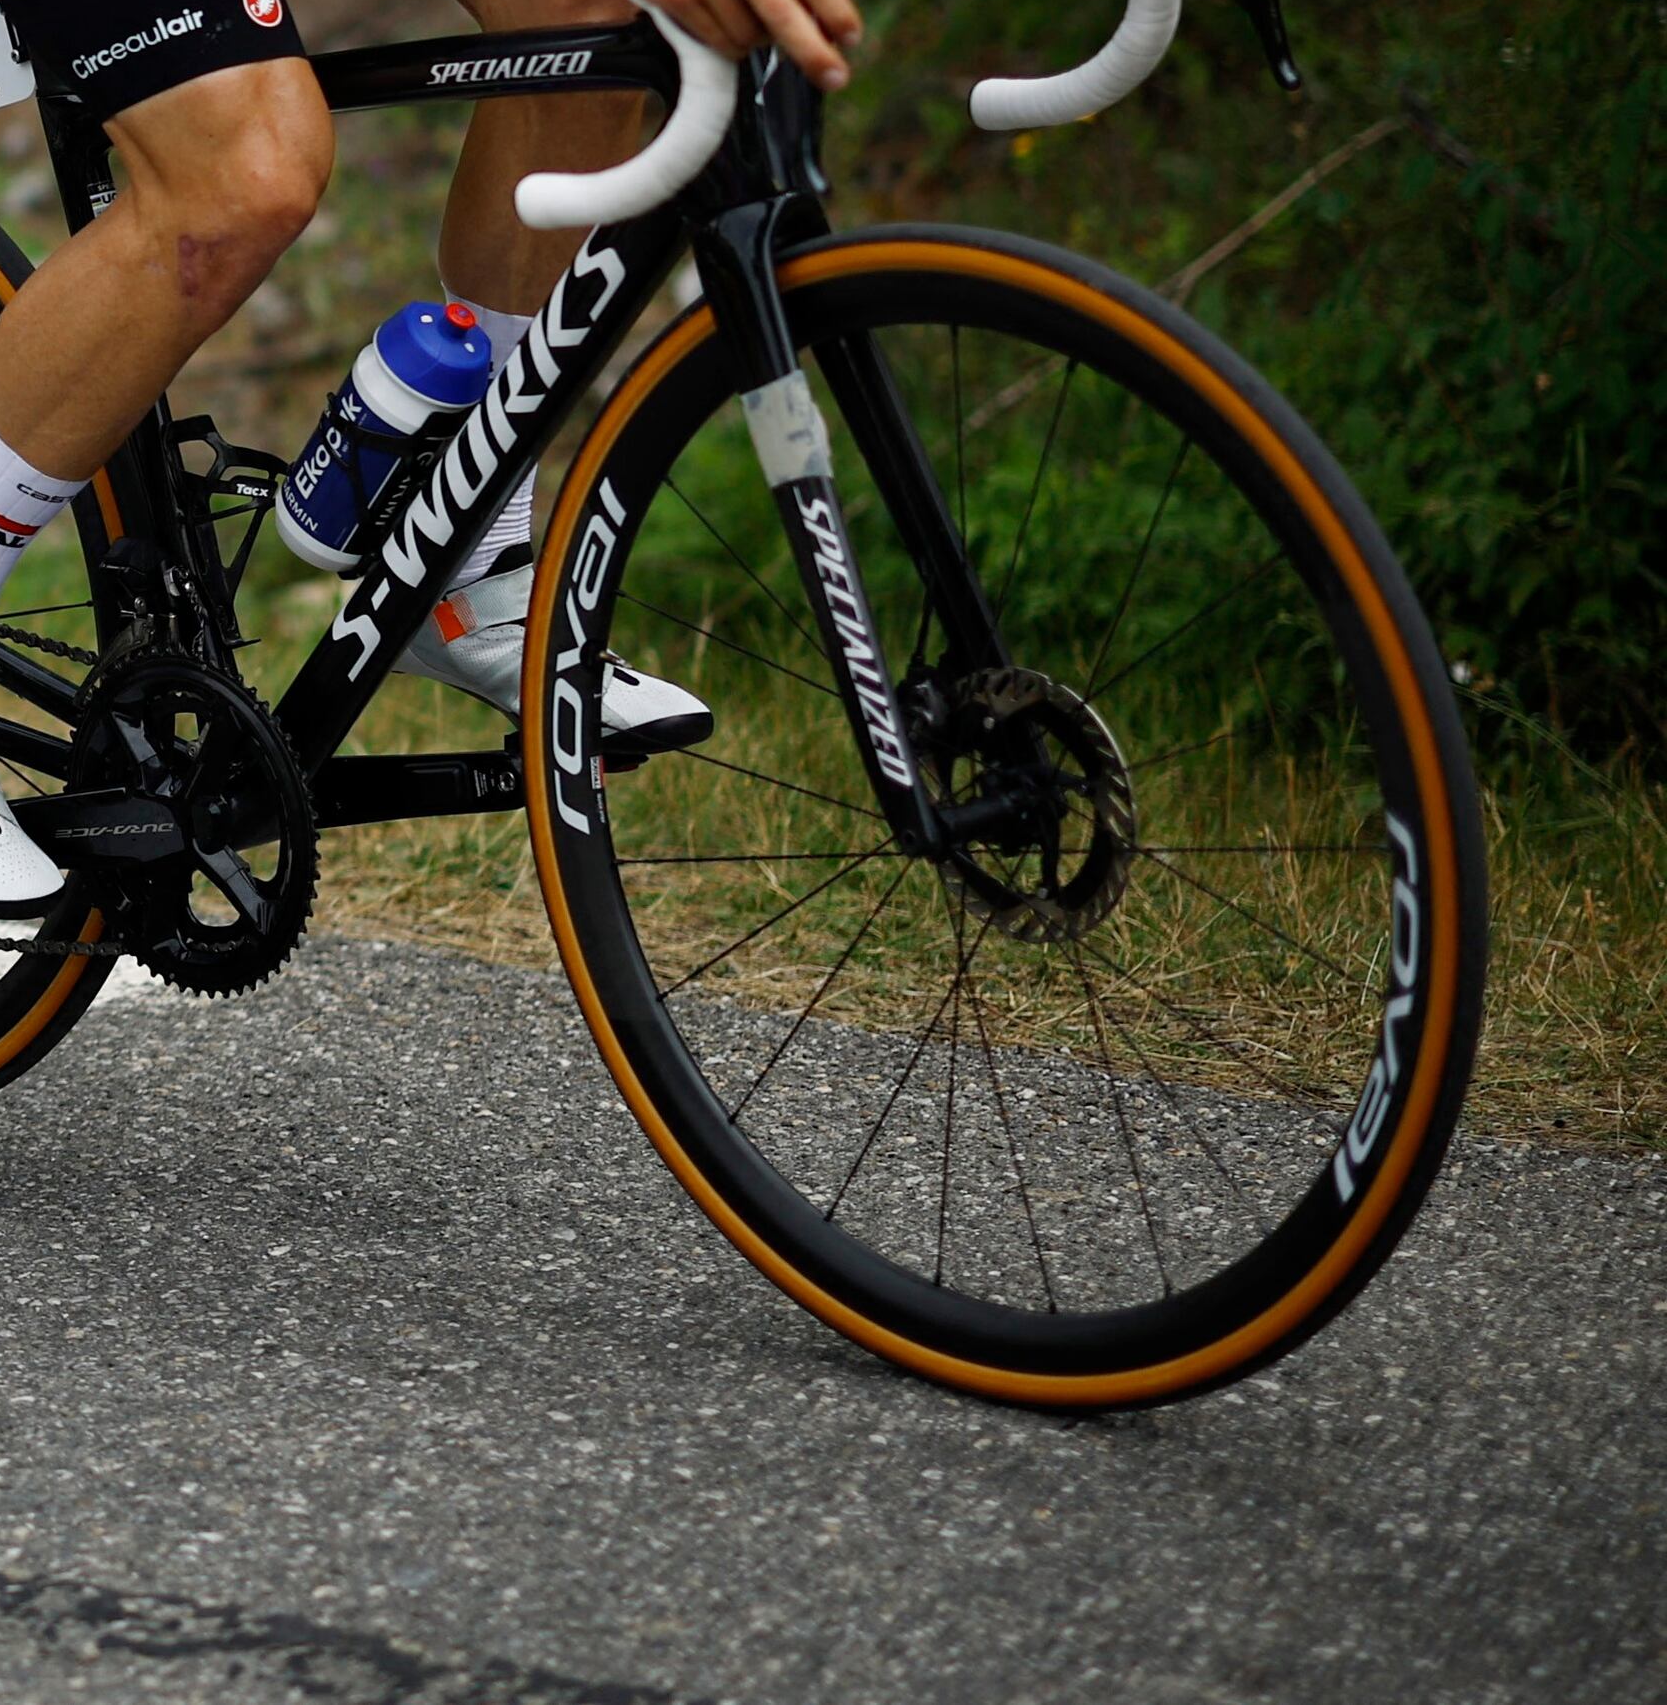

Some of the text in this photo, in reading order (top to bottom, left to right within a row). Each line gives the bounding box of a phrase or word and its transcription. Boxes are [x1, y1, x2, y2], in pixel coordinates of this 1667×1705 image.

[71, 8, 204, 82] Circeaulair
[426, 49, 593, 86] SPECIALIZED
[235, 482, 269, 498] Tacx
[295, 392, 363, 501] Ekopk
[331, 244, 627, 682] S-WORKS
[552, 477, 626, 836] roval
[798, 485, 915, 790] SPECIALIZED
[1335, 811, 1417, 1202] roval
